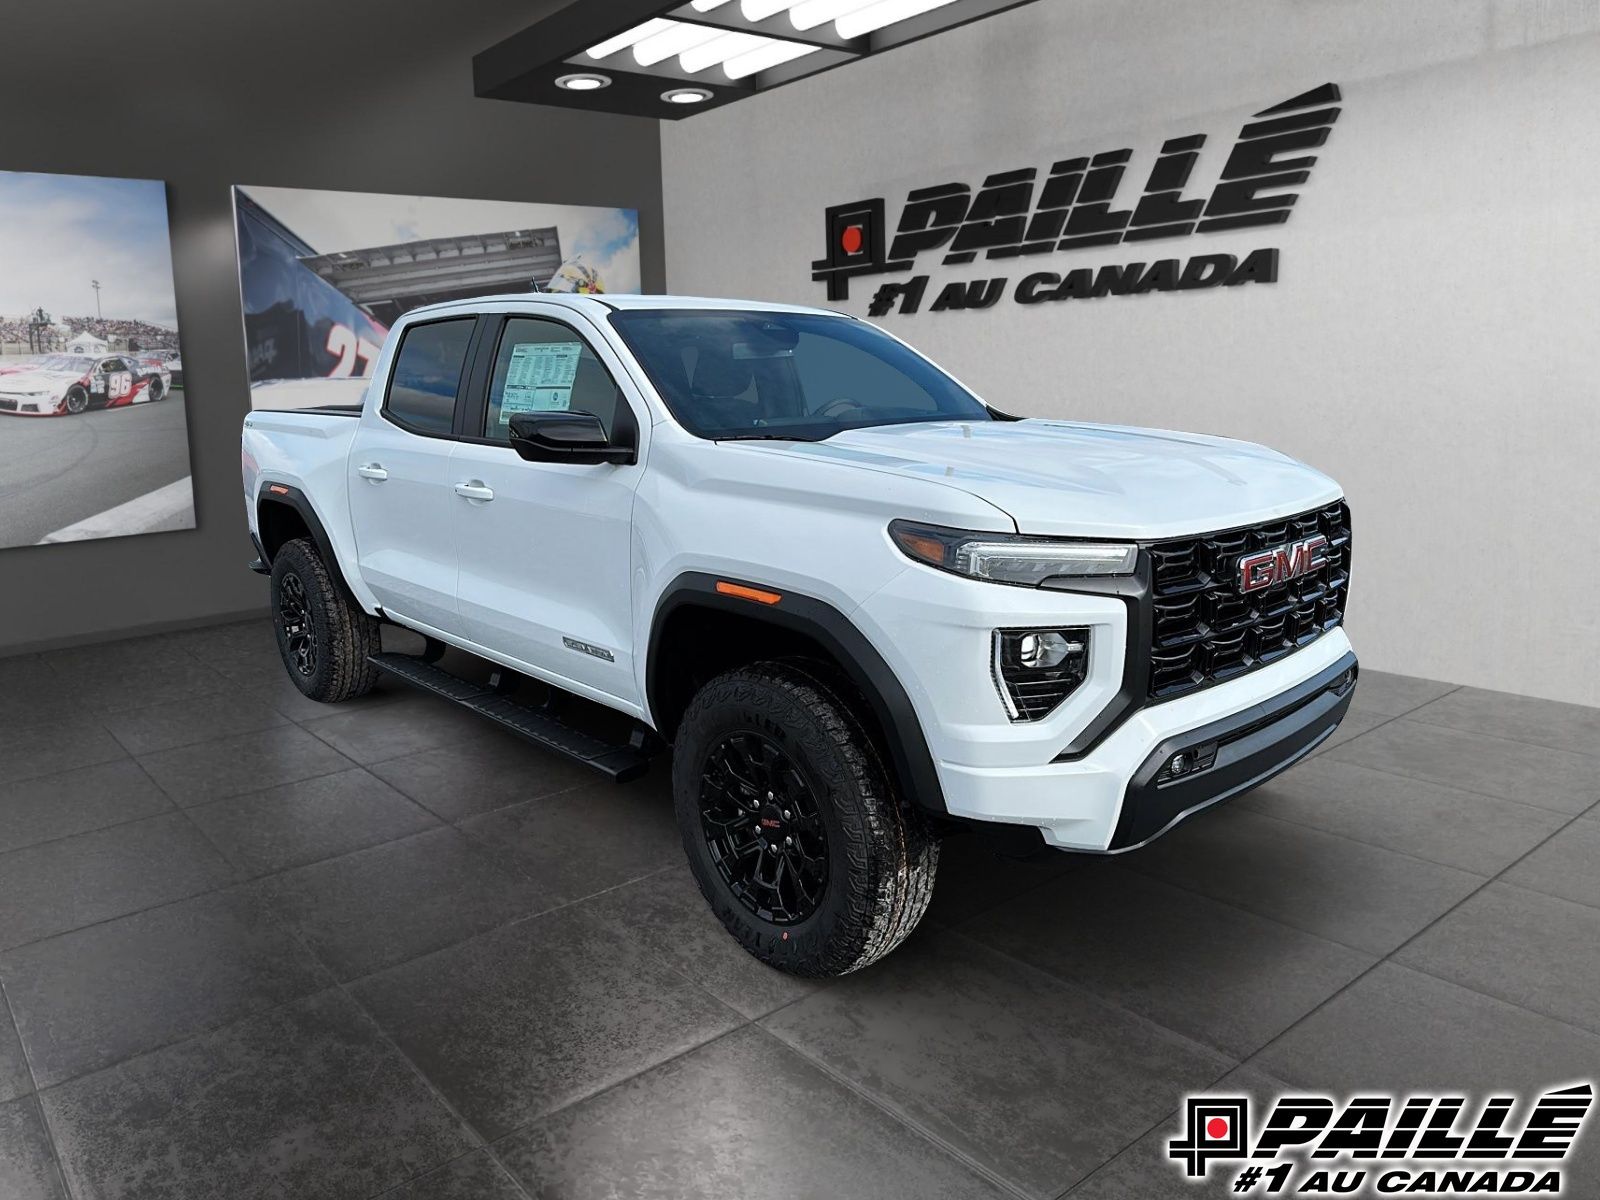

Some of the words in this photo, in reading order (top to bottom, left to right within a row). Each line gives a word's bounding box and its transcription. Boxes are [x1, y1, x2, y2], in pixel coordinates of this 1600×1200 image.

[888, 82, 1342, 265] PAILLÉ
[868, 275, 930, 317] #1
[928, 278, 1008, 311] AU
[1013, 248, 1280, 305] CANADA
[108, 370, 133, 400] 96
[1240, 535, 1328, 594] GMC
